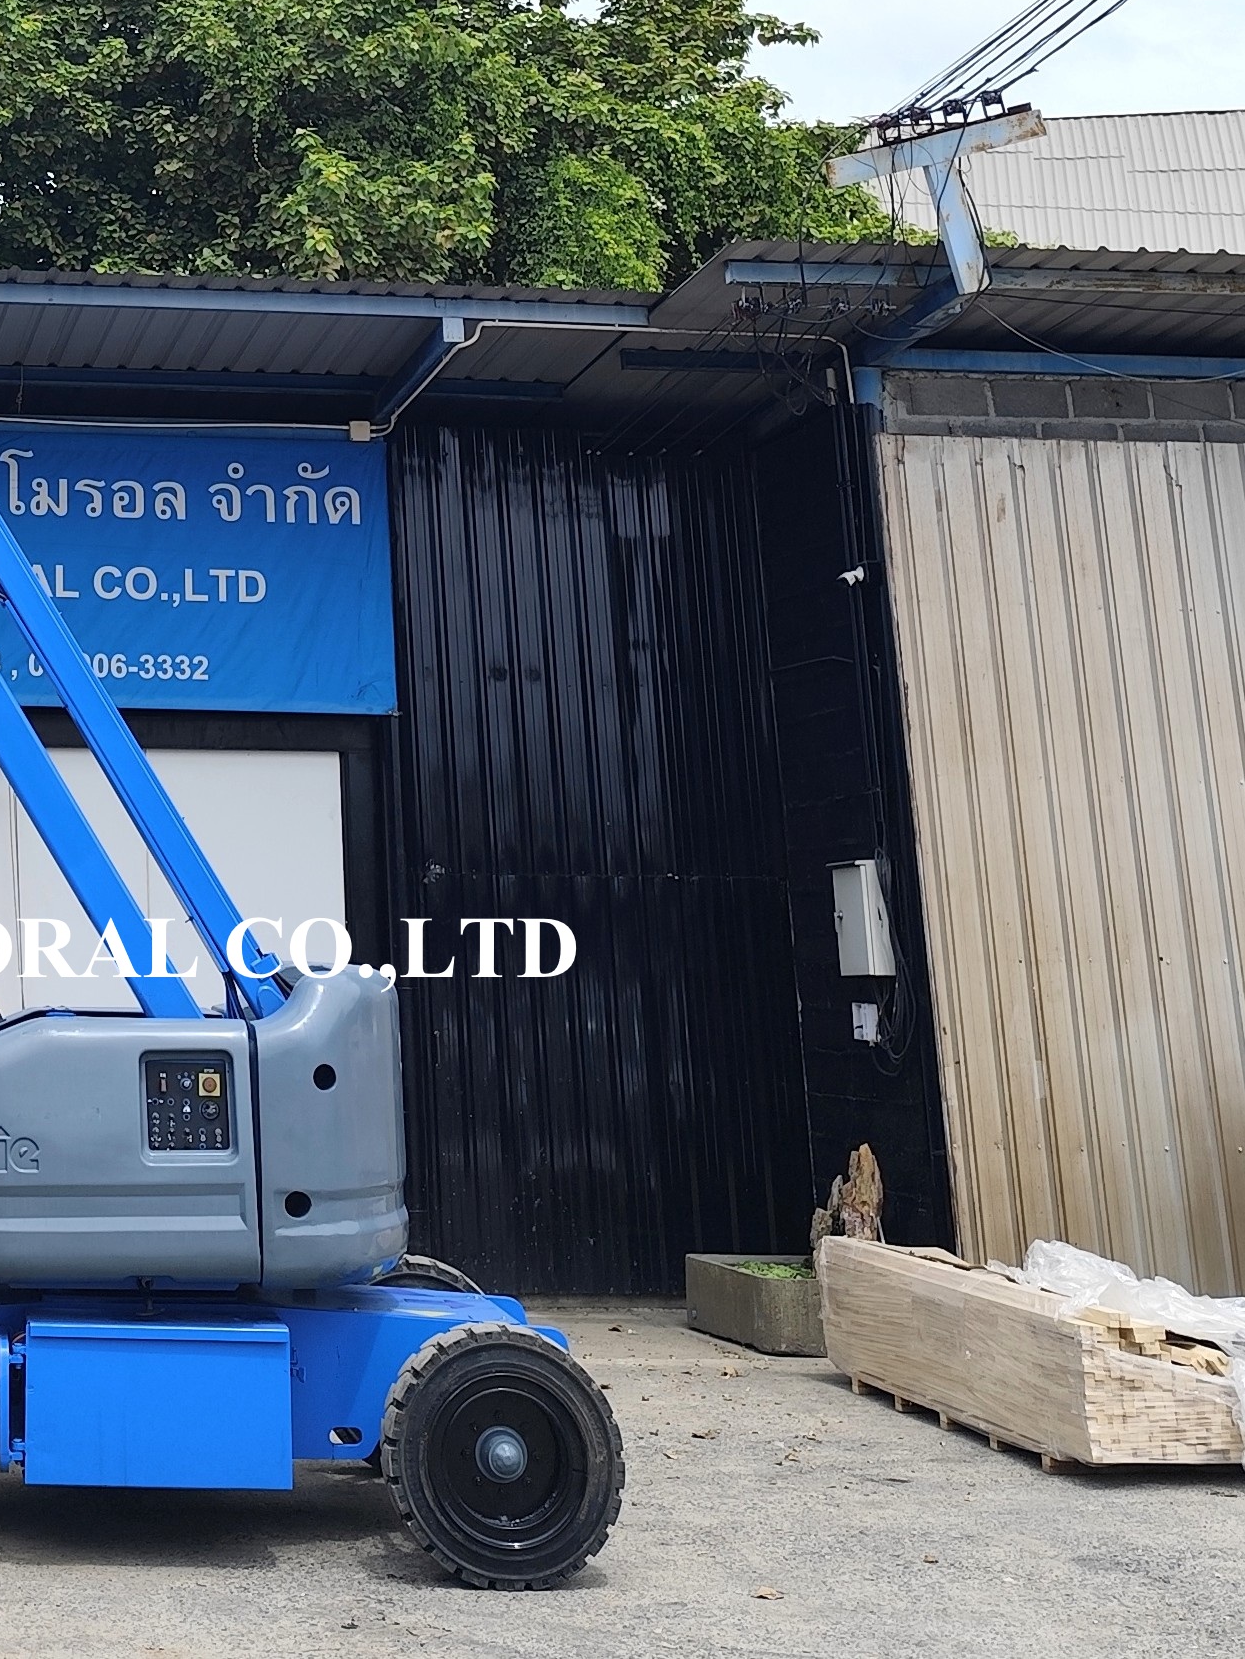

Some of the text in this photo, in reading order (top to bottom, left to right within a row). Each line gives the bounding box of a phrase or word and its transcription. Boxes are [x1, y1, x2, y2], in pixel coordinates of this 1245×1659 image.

[0, 448, 186, 521] โมรอล
[207, 462, 361, 525] จำกัด
[93, 565, 267, 608] CO.,LTD
